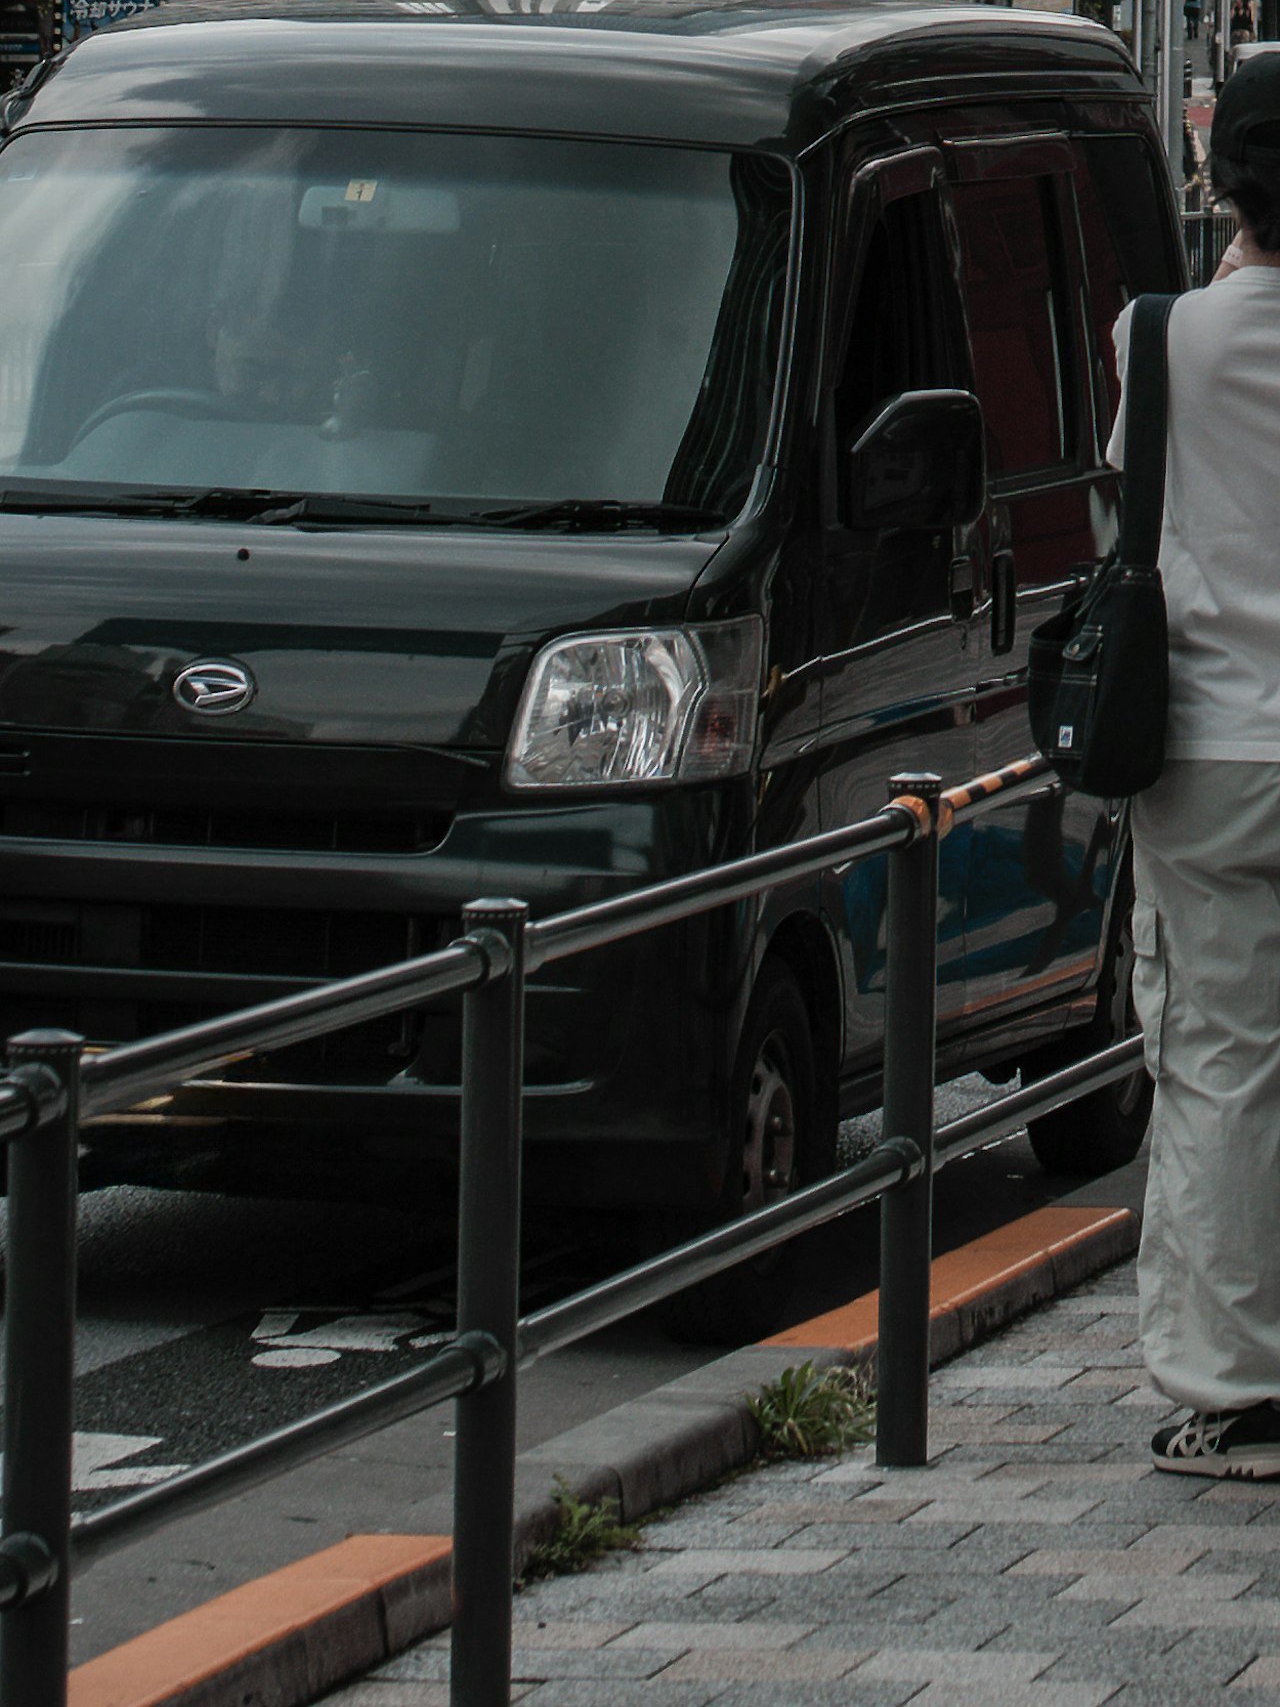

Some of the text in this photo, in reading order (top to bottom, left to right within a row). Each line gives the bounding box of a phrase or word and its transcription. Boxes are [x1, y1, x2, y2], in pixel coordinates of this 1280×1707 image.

[70, 0, 154, 18] 冷却サウナ
